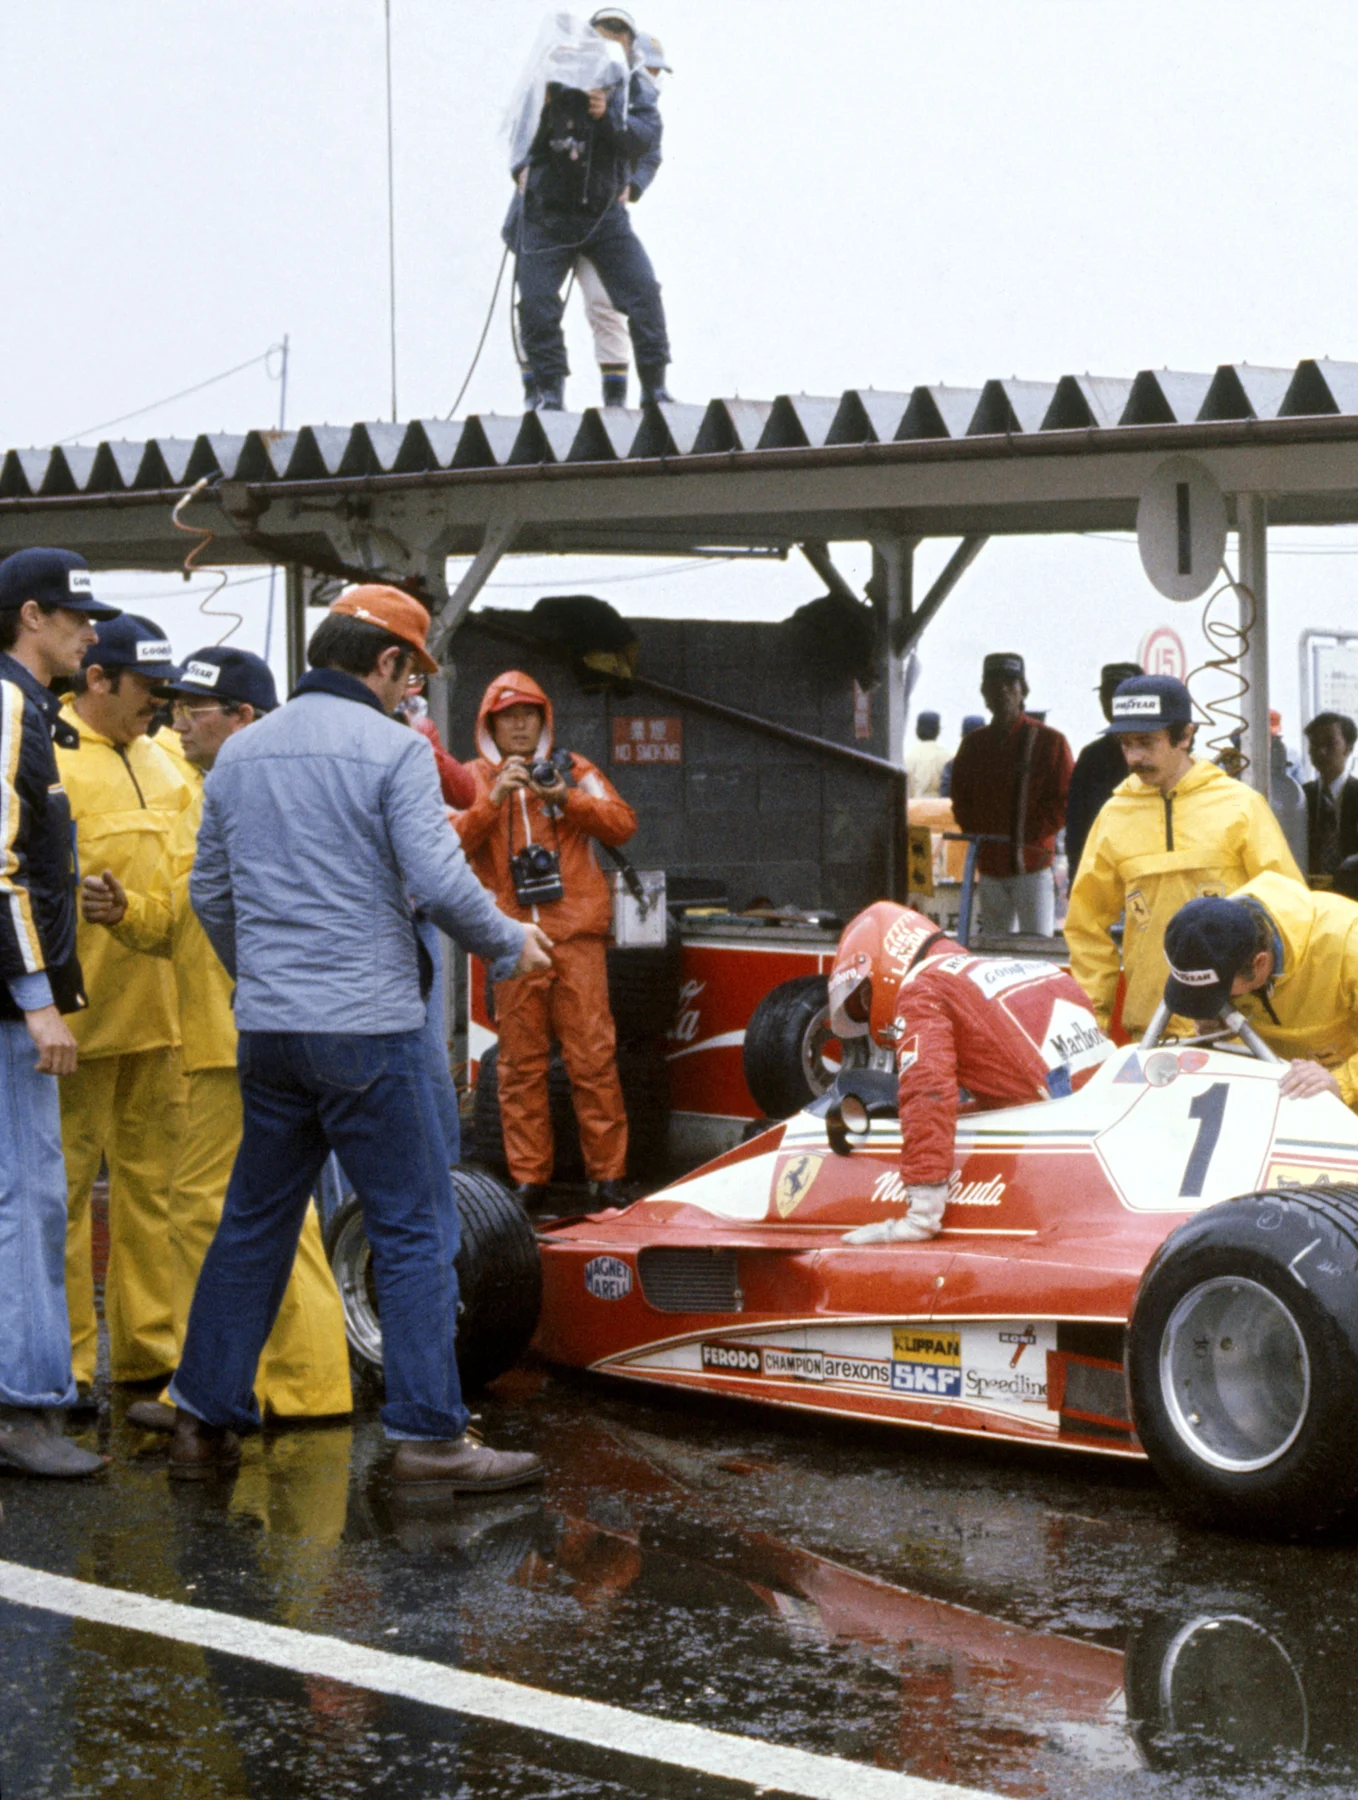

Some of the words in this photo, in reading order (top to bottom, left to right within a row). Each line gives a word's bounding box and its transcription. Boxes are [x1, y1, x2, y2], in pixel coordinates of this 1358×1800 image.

[1178, 1082, 1231, 1198] 1
[893, 1334, 960, 1357] KLIPPAN
[1001, 1333, 1035, 1344] KONI
[703, 1346, 760, 1369] FERODO
[765, 1353, 822, 1376] CHAMPION
[825, 1359, 890, 1382] arexons
[893, 1363, 956, 1393] SKF
